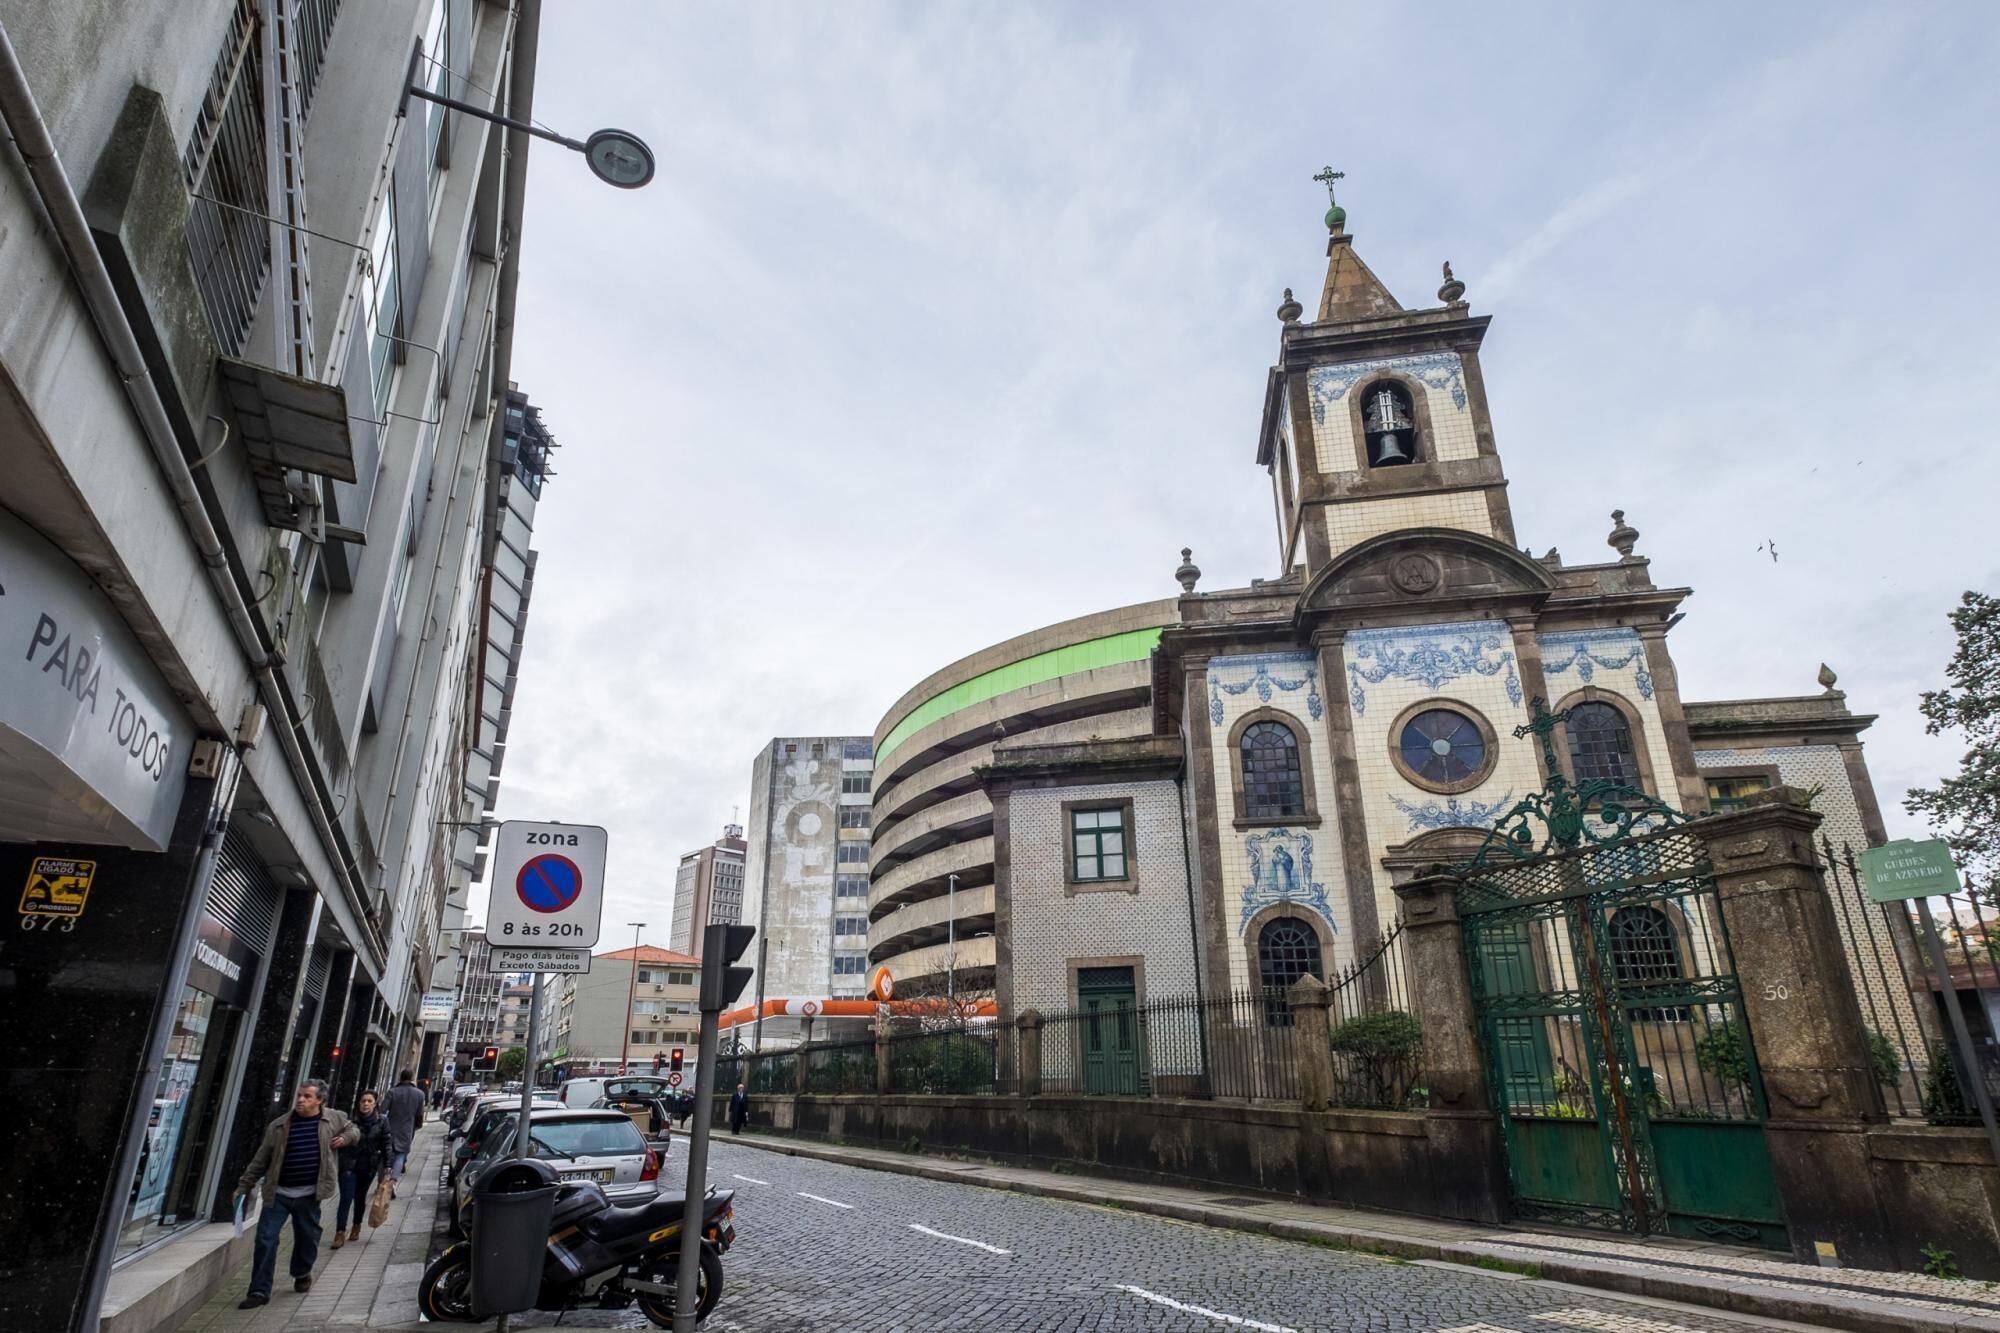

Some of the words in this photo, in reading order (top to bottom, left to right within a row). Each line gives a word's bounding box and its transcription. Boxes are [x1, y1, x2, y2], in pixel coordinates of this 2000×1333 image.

[26, 612, 102, 715] PARA
[108, 688, 168, 782] TODOS
[526, 832, 579, 847] zona
[37, 865, 75, 874] LIGADO
[39, 860, 76, 868] ALARME
[1884, 856, 1927, 870] GUEDES
[1876, 872, 1889, 883] DE
[1895, 866, 1942, 880] AZEVEDO
[21, 914, 77, 933] 673
[503, 922, 514, 935] 8
[522, 923, 541, 936] às
[548, 923, 583, 937] 20h
[502, 951, 529, 961] Pago
[531, 951, 552, 960] dias
[555, 951, 579, 961] úteis
[499, 960, 535, 970] Exceto
[537, 960, 580, 971] Sábados
[1764, 984, 1788, 1001] 50
